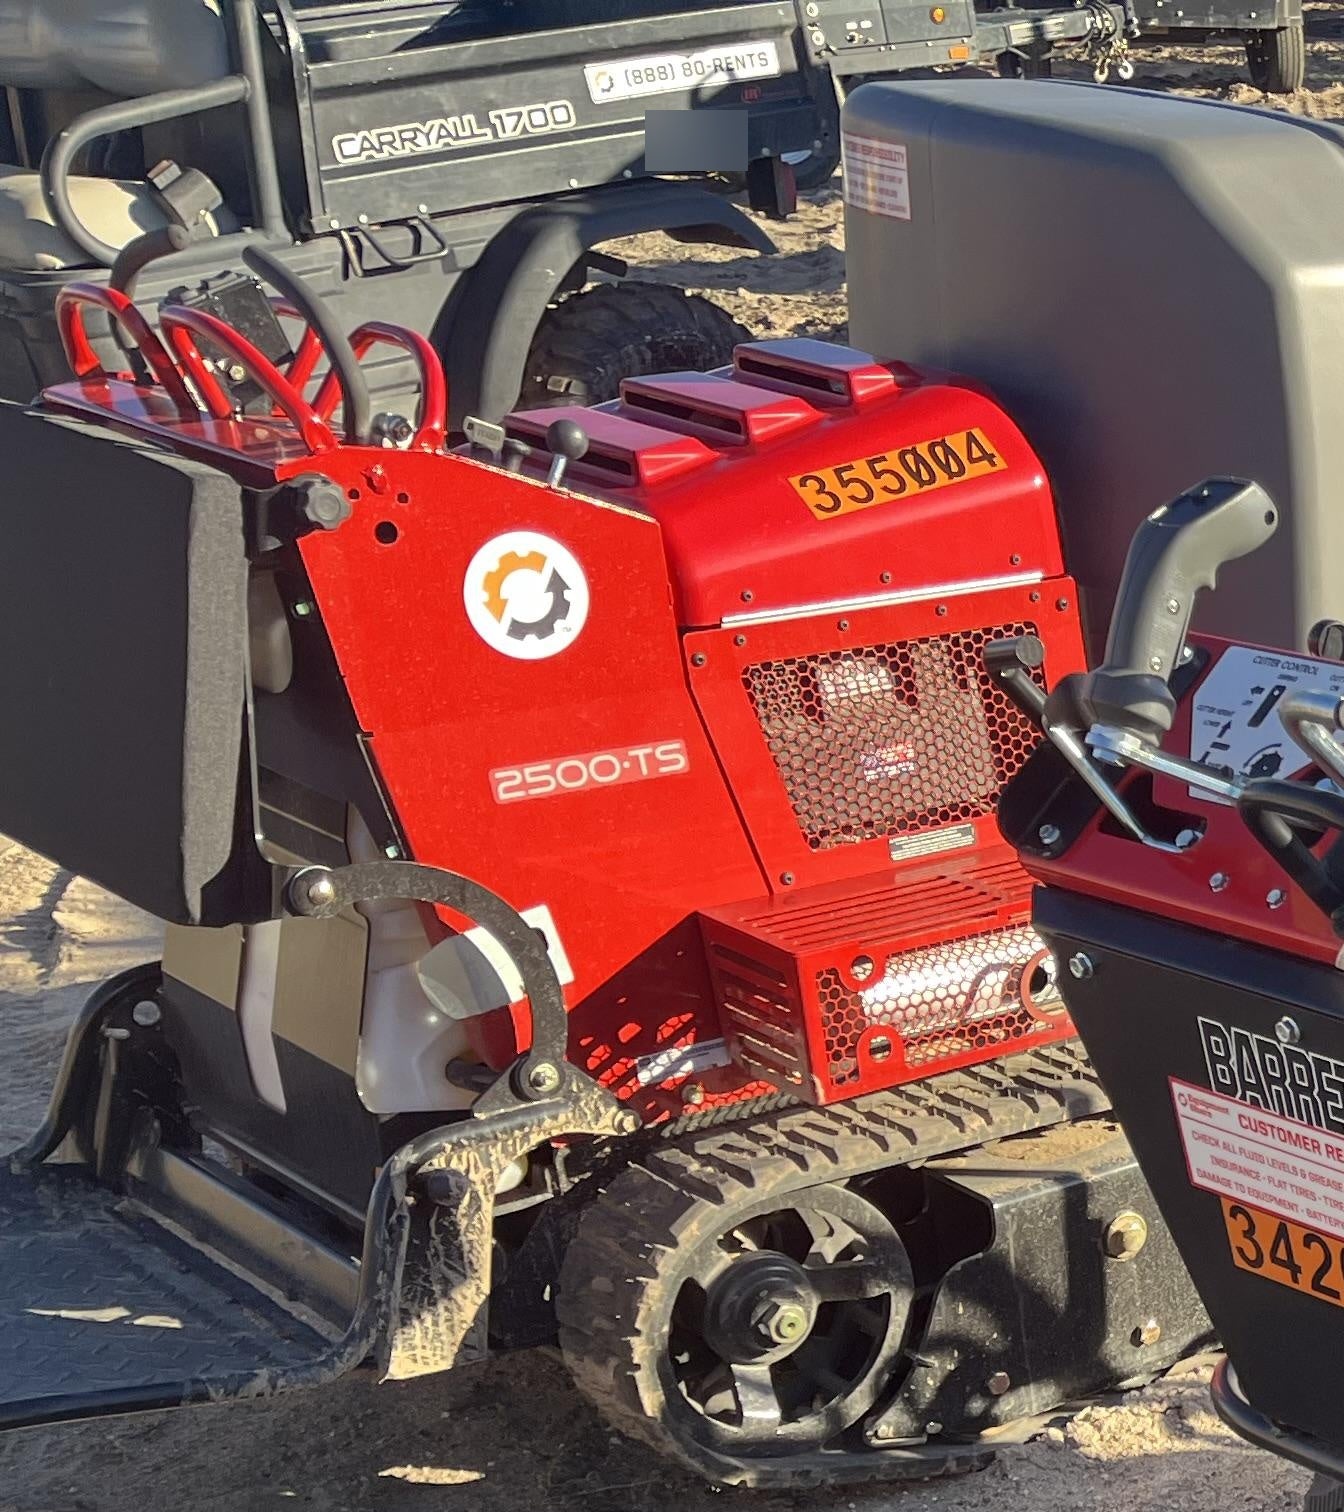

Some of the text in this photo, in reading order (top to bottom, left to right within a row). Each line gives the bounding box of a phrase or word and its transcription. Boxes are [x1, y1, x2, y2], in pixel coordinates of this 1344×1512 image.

[624, 50, 770, 88] (888) 80-RENTS
[332, 100, 577, 164] CARRYALL 1700
[799, 428, 998, 514] 355004
[1237, 1113, 1323, 1157] CUSTOMER
[1191, 1130, 1221, 1149] CHECK
[1266, 1157, 1299, 1177] LEVELS
[1308, 1172, 1344, 1193] GREASE
[1196, 1168, 1233, 1190] DAMAGE
[1234, 1182, 1246, 1194] TO
[1267, 1175, 1288, 1192] FLAT
